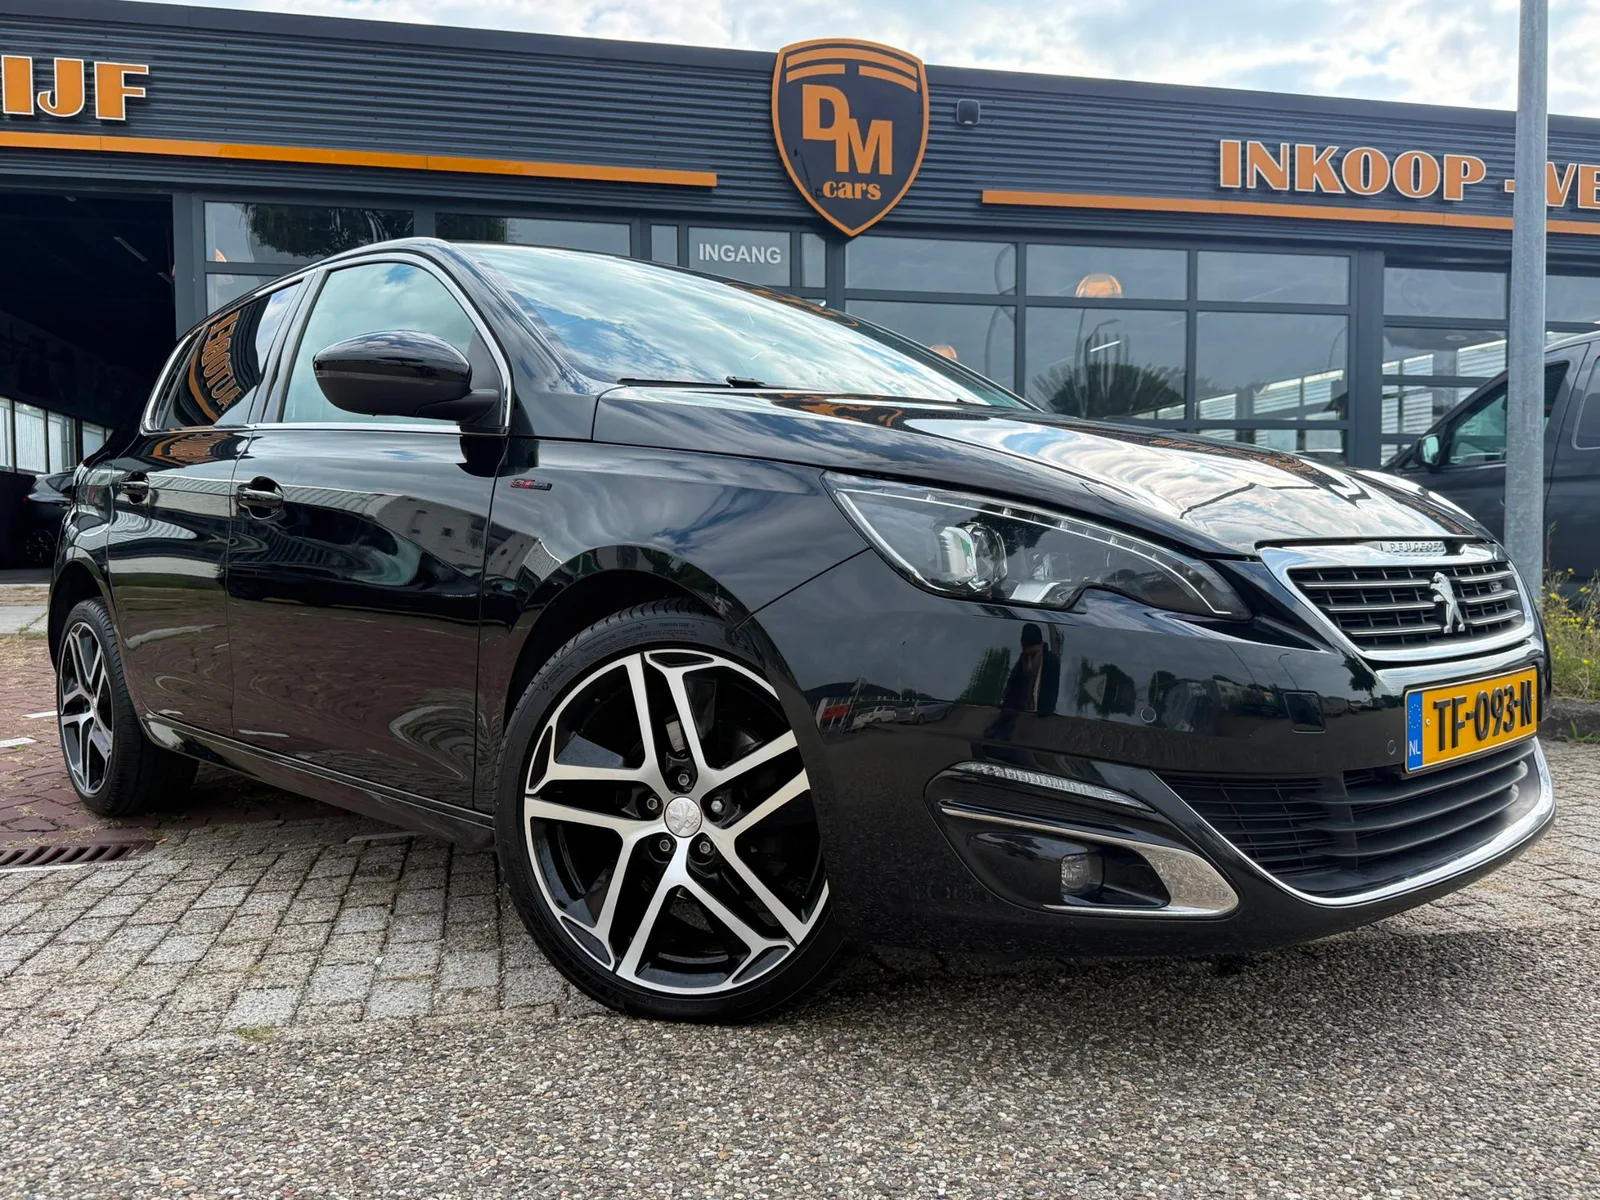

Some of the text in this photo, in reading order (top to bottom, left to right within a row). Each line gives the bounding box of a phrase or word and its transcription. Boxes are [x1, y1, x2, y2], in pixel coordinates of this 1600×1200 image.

[1, 55, 149, 121] IJF
[802, 83, 893, 176] DM
[822, 180, 882, 200] cars
[1219, 139, 1487, 201] INKOOP
[699, 243, 781, 264] INGANG
[1433, 679, 1532, 752] TF-093-N
[1409, 739, 1421, 757] NL
